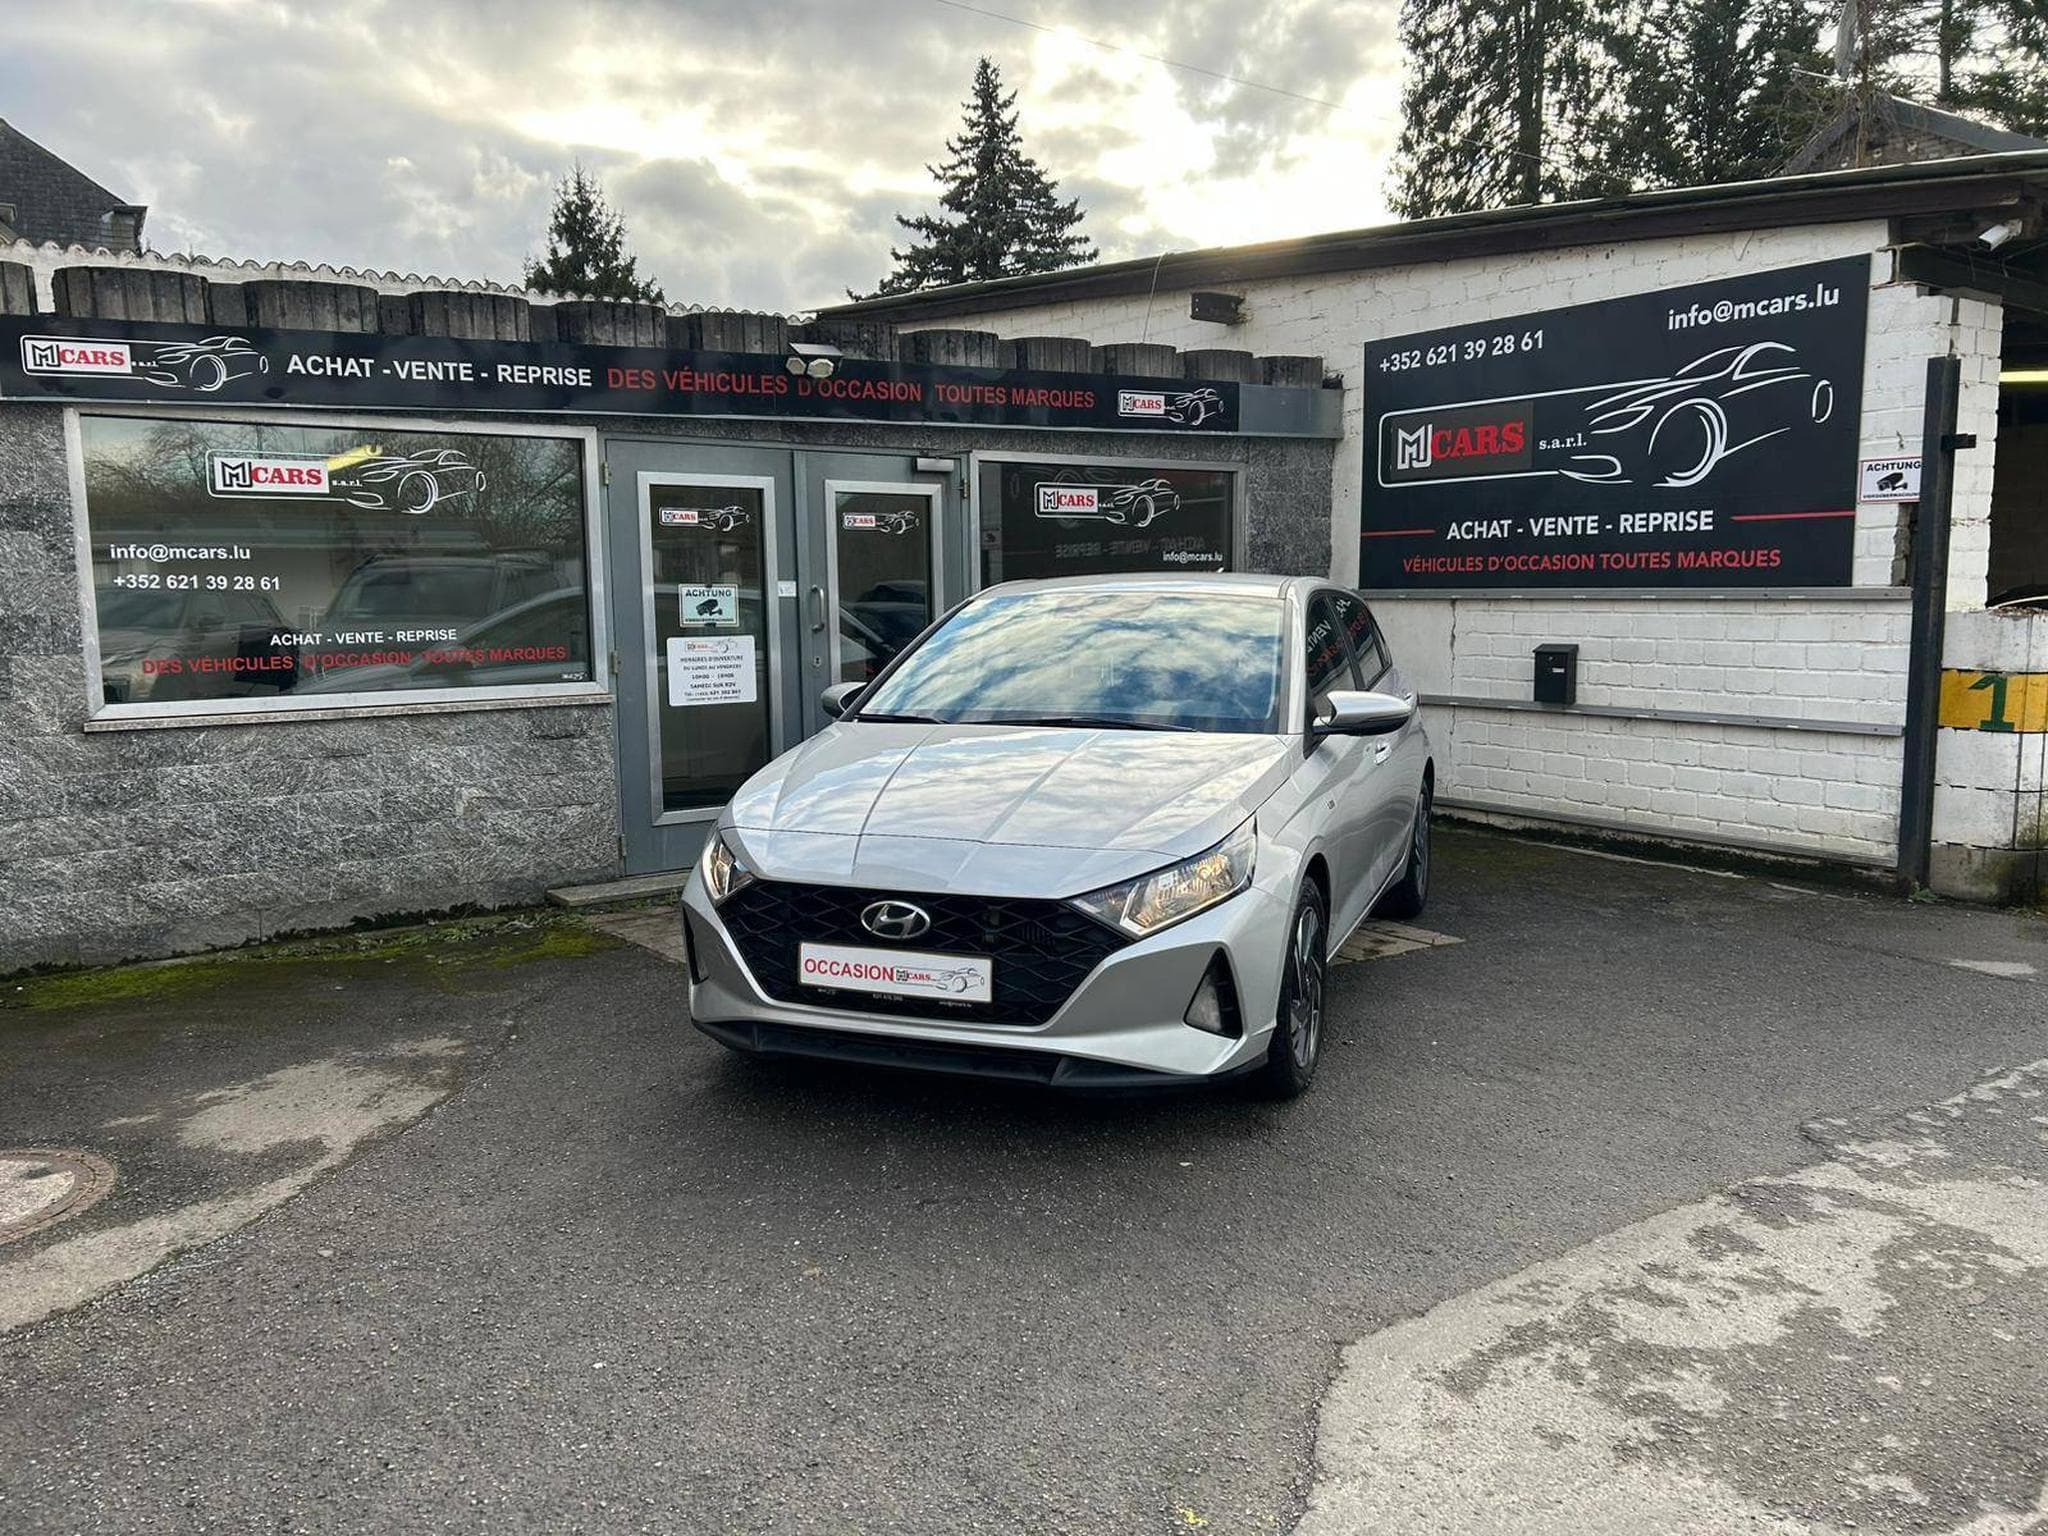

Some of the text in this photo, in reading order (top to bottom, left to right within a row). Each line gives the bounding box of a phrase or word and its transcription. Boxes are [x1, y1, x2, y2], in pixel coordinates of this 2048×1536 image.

[1668, 283, 1839, 331] info@mcars.lu
[1380, 330, 1544, 372] +352 621 39 28 61
[286, 354, 375, 378] ACHAT
[497, 364, 592, 387] REPRISE
[607, 368, 656, 389] DES
[662, 366, 788, 394] VÉHICULES
[935, 384, 1006, 404] TOUTES
[1012, 388, 1095, 409] MARQUES
[1539, 433, 1587, 450] s.a.r.l.
[1866, 461, 1922, 471] ACHTUNG
[1446, 520, 1512, 540] ACHAT
[1529, 515, 1599, 537] VENTE
[1619, 510, 1714, 534] REPRISE
[110, 544, 250, 563] info@mcars.lu
[1163, 552, 1224, 564] info@mcars.lu
[1403, 549, 1781, 573] VÉHICULES D'OCCASION TOUTES MARQUES
[113, 574, 280, 590] +352 621 39 28 61
[685, 588, 732, 597] ACHTUNG
[270, 633, 322, 646] ACHAT
[335, 631, 384, 645] VENTE
[396, 629, 457, 642] REPRISE
[143, 658, 183, 674] DES
[188, 655, 294, 673] VÉHICULES
[490, 646, 567, 661] MARQUES
[1968, 675, 2015, 731] 1
[804, 958, 895, 982] OCCASION
